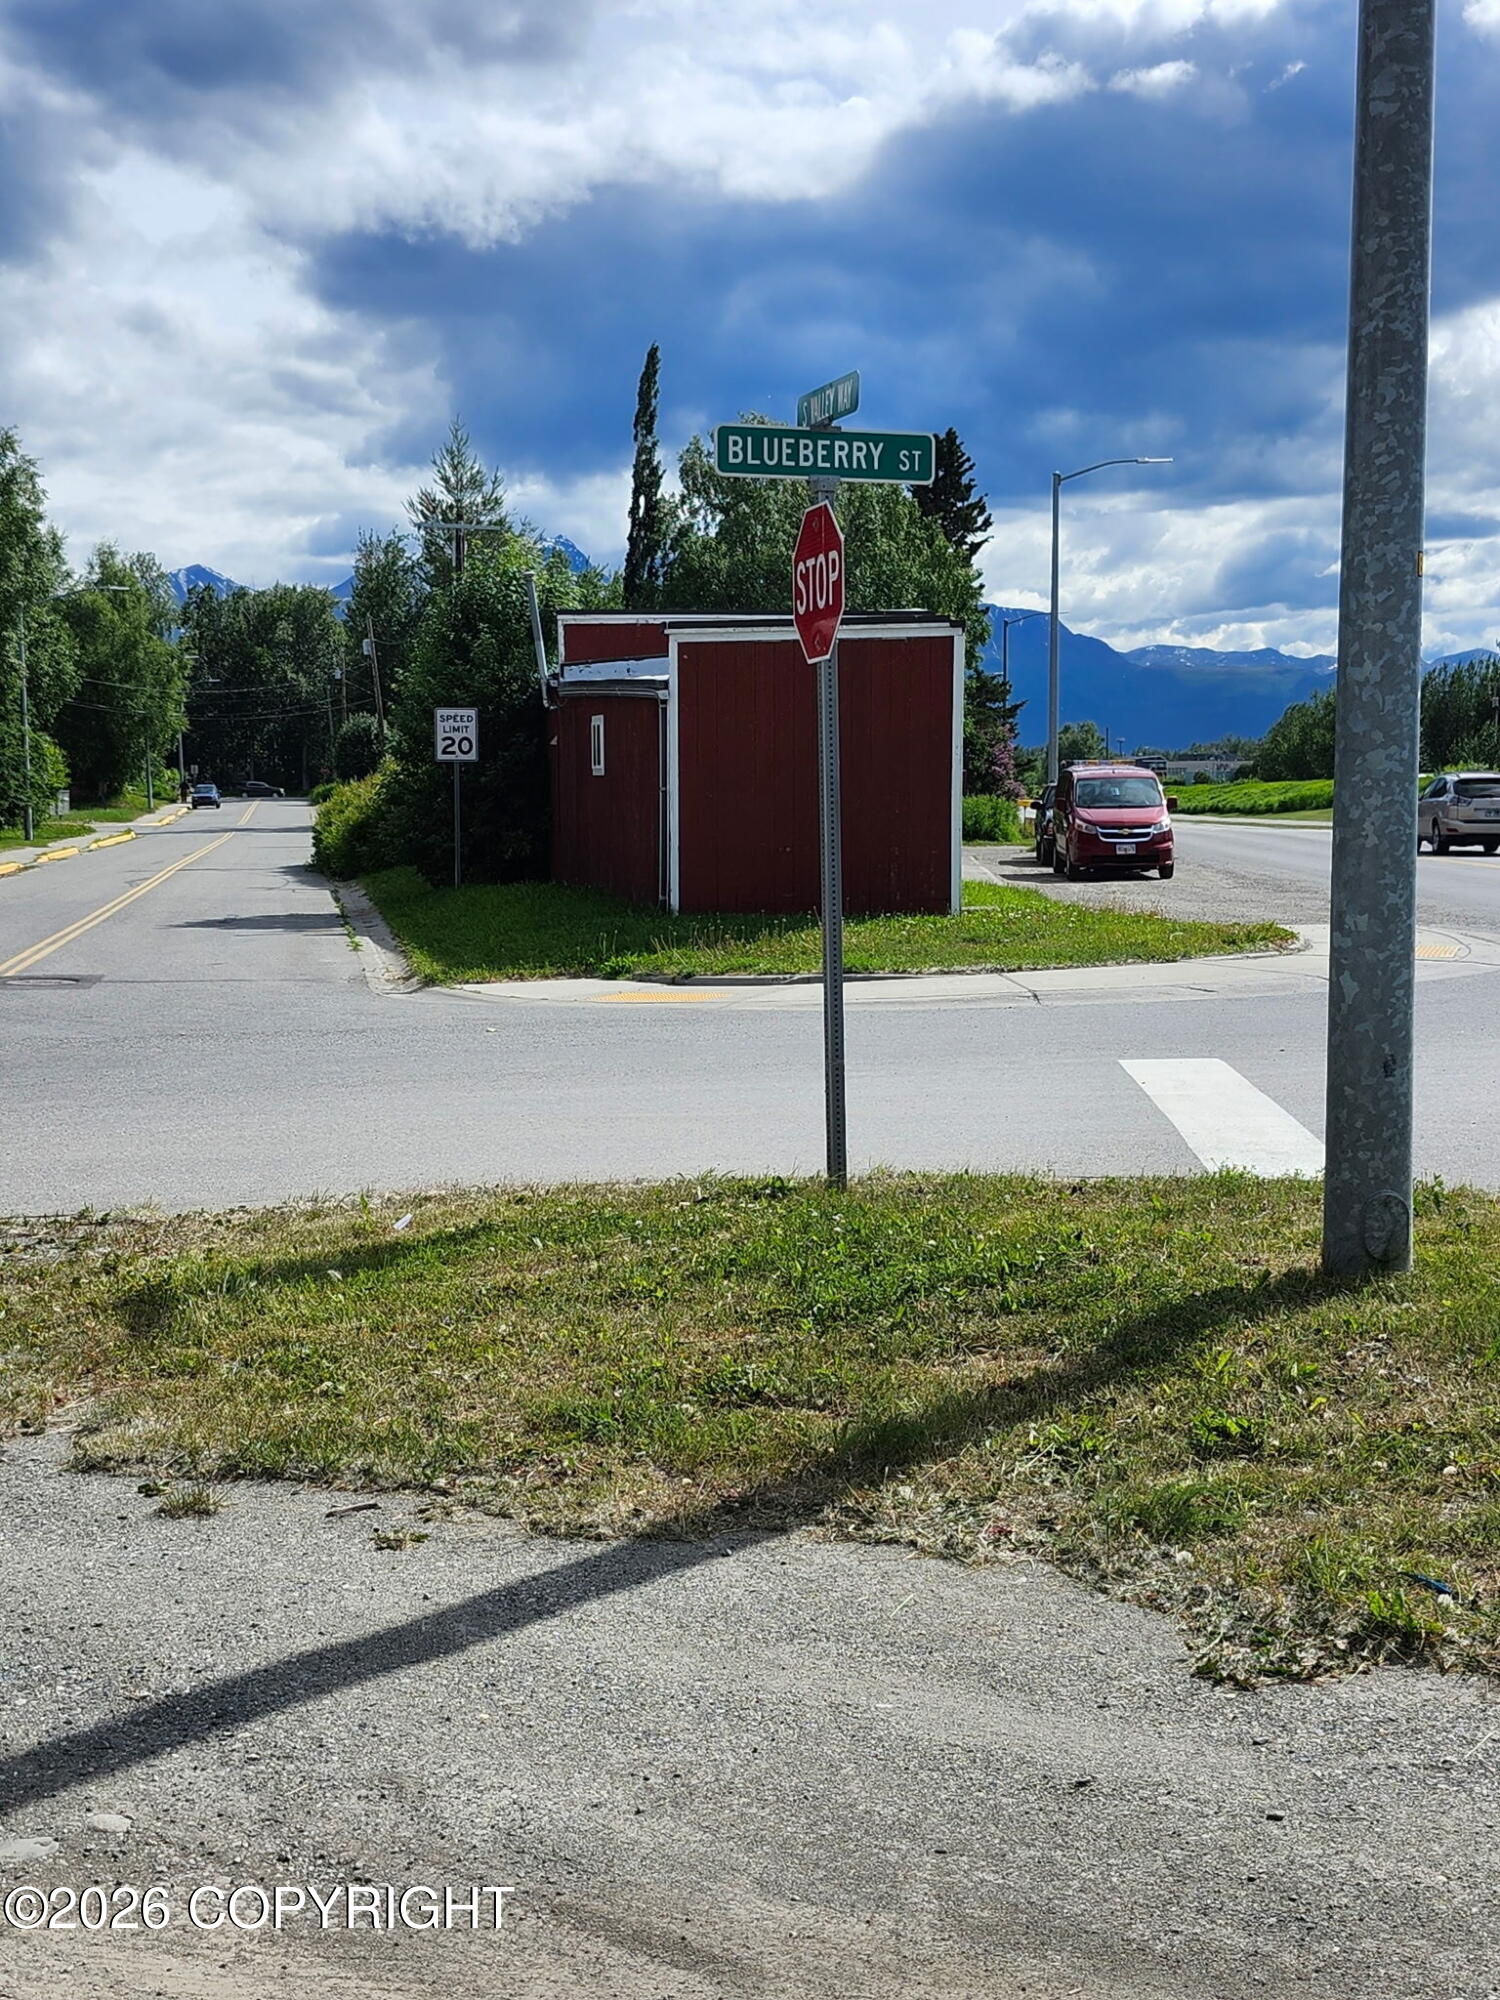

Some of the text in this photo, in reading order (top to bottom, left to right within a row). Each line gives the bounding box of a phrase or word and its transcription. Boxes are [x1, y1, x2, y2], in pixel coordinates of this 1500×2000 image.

[802, 379, 853, 427] S VALLEY WAY
[727, 435, 922, 472] BLUEBERRY ST
[796, 550, 840, 616] STOP
[439, 714, 474, 723] SPEED
[442, 725, 470, 734] LIMIT
[441, 736, 473, 756] 20
